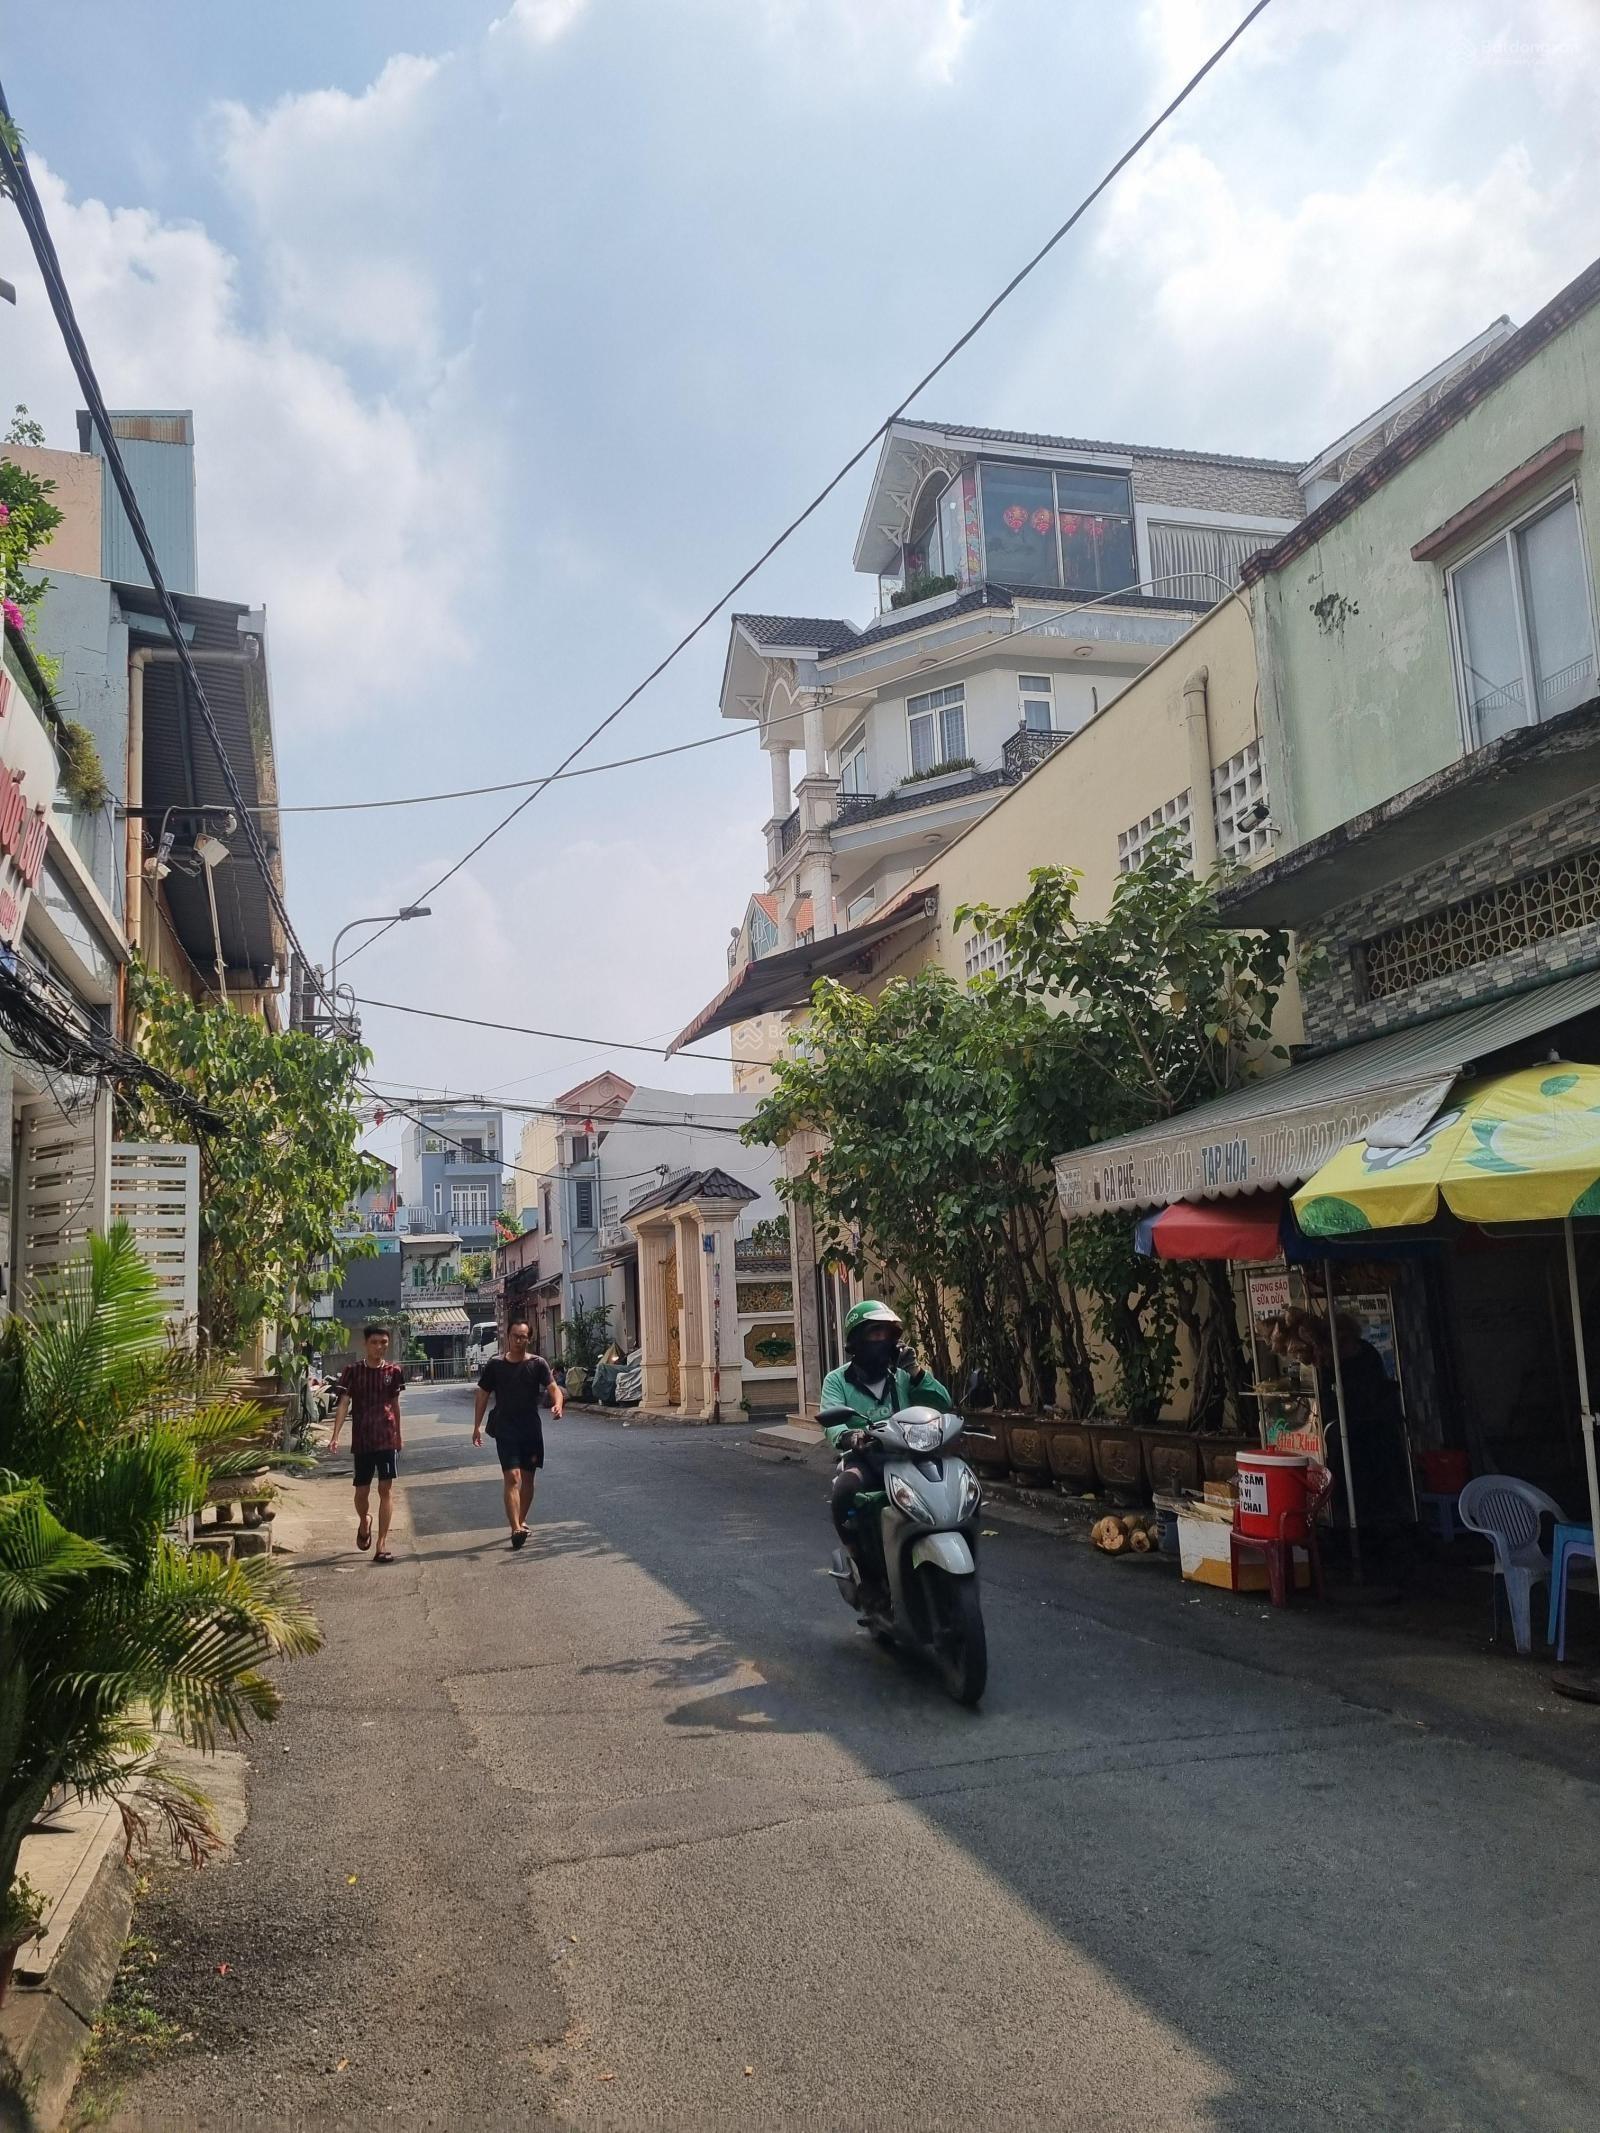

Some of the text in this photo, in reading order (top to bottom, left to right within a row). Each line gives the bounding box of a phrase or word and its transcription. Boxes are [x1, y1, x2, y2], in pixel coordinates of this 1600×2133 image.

[1103, 1159, 1117, 1203] CÀ
[1117, 1154, 1136, 1200] PHÊ
[1144, 1147, 1171, 1198] NƯỚC
[1173, 1142, 1193, 1195] MÍA
[1202, 1143, 1222, 1195] TẠP
[1225, 1132, 1248, 1185] HÓA
[1257, 1120, 1296, 1179] NƯỚC
[1243, 1501, 1262, 1513] CHAI
